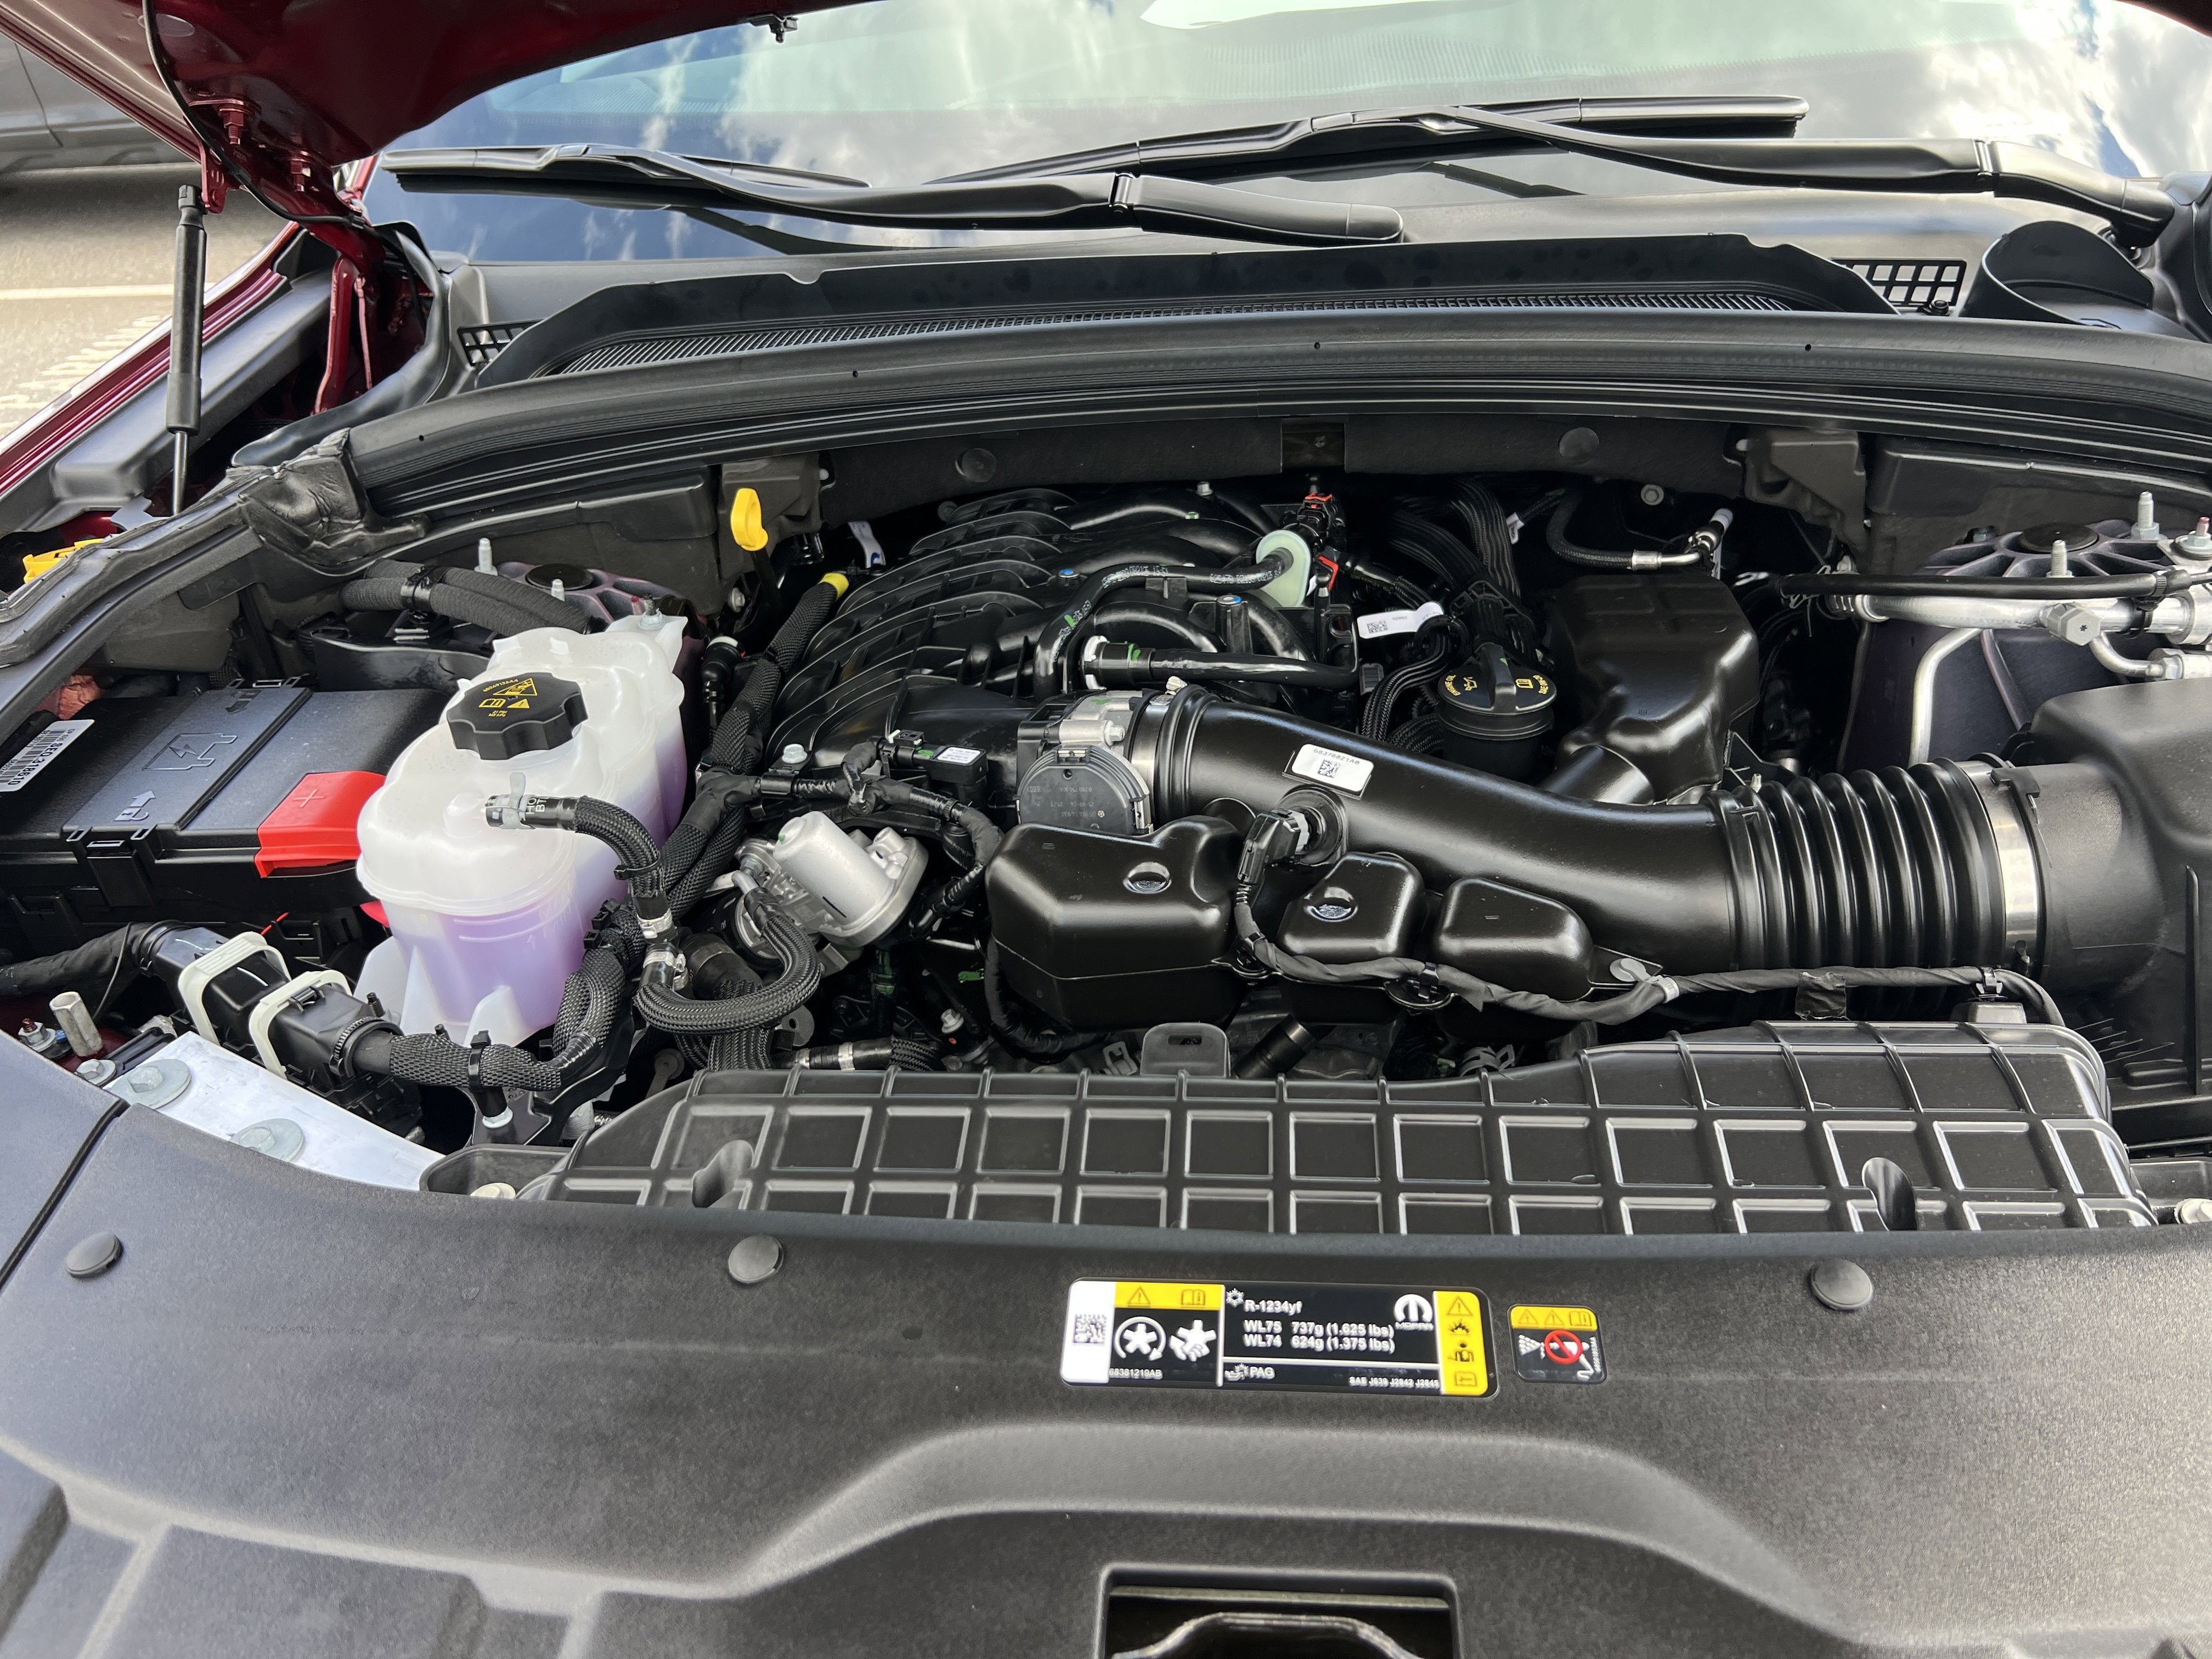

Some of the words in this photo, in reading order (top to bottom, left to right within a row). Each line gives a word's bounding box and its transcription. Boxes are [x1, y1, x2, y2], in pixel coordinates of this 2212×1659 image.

[1244, 1299, 1303, 1316] R-1234yf
[1243, 1319, 1283, 1334] WL75
[1291, 1321, 1324, 1338] 737g
[1325, 1322, 1367, 1337] (1.625
[1368, 1323, 1395, 1339] lbs)
[1395, 1322, 1435, 1331] MOPAR
[1243, 1333, 1283, 1348] WL74
[1291, 1335, 1324, 1352] 624g
[1326, 1336, 1367, 1352] (1.375
[1368, 1338, 1396, 1355] lbs)
[1250, 1367, 1276, 1379] PAG
[1349, 1376, 1368, 1387] SAE
[1368, 1377, 1389, 1387] J639
[1415, 1379, 1440, 1390] J2845
